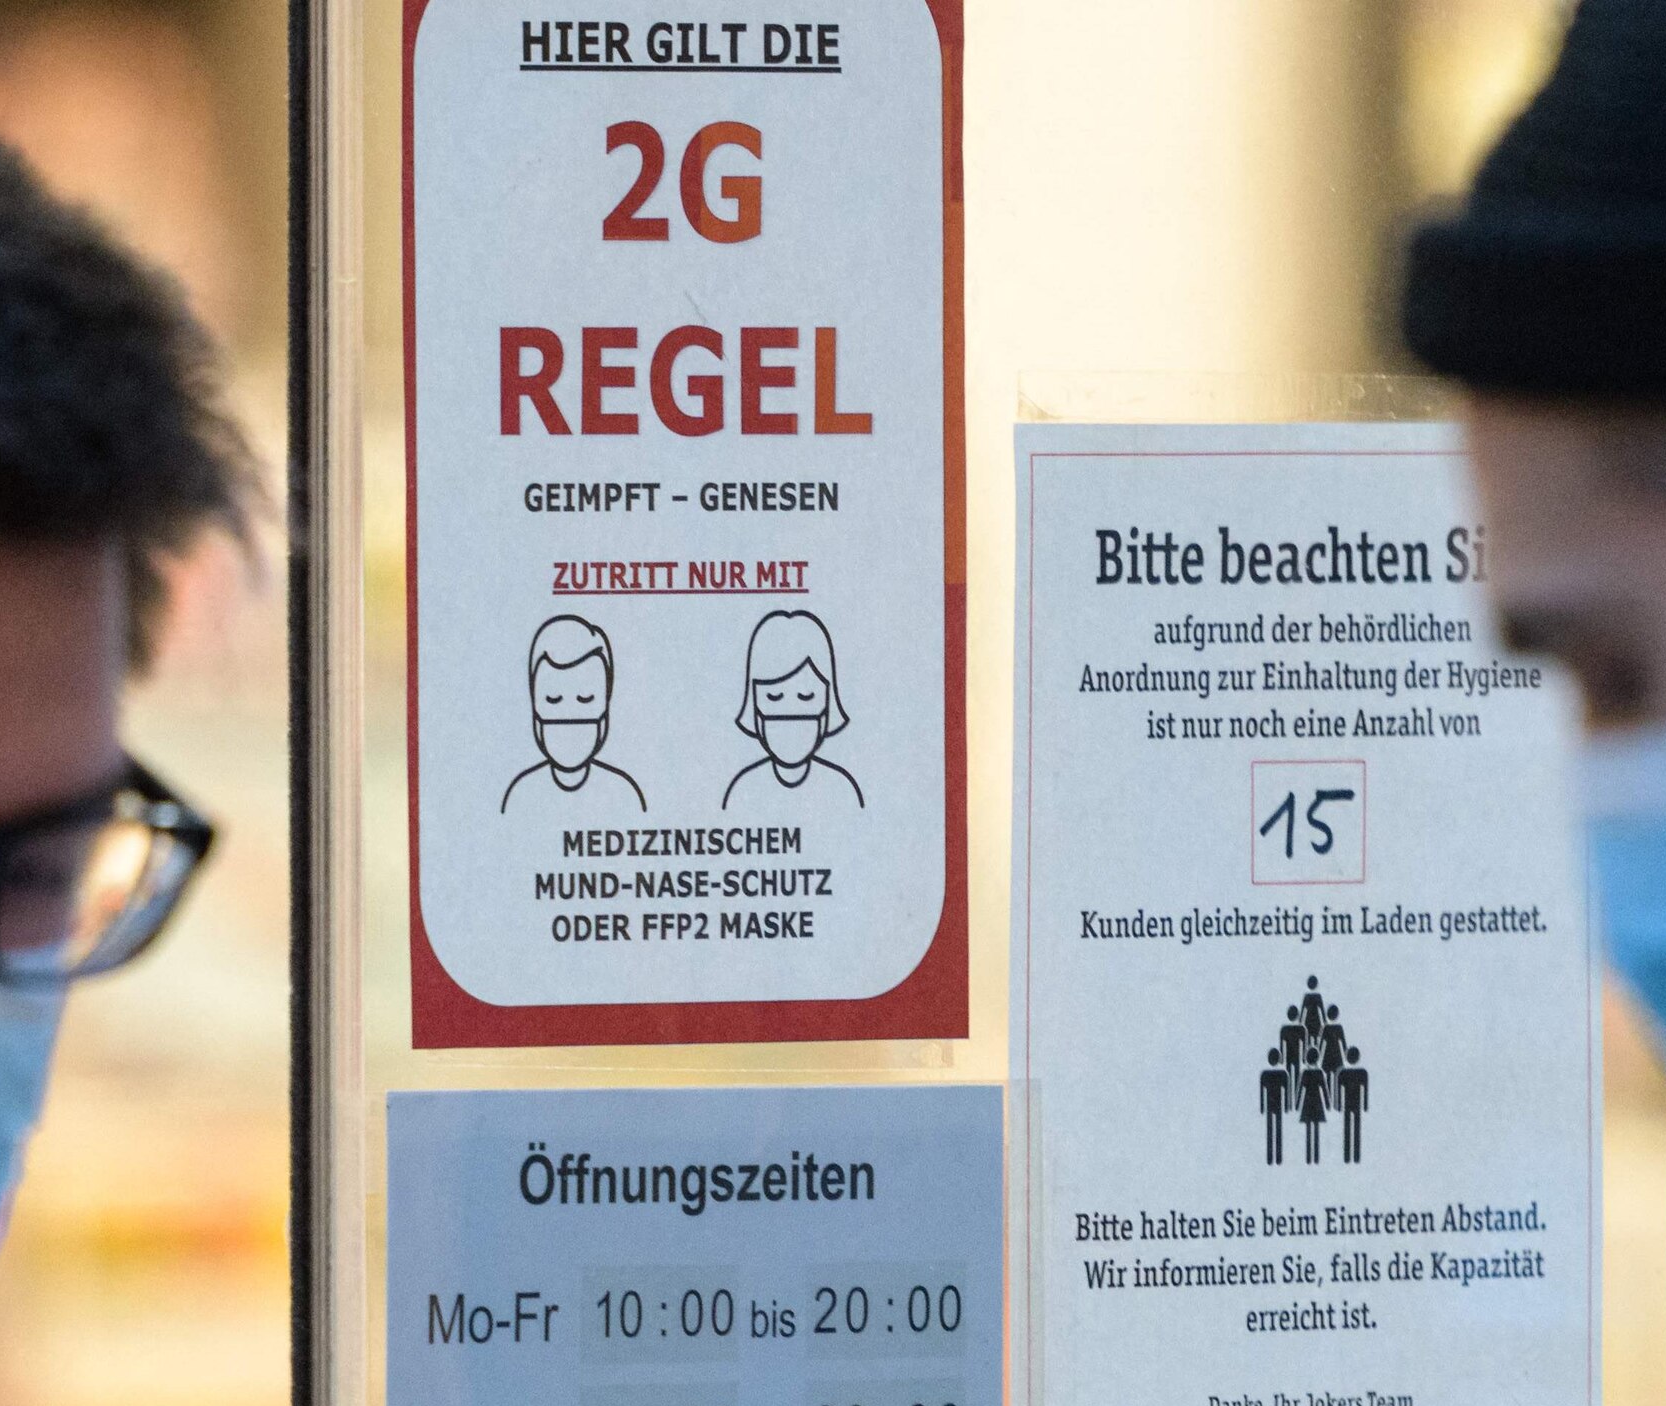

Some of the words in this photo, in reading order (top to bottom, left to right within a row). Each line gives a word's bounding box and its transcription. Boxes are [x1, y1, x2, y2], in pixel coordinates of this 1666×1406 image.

[522, 21, 633, 64] HIER
[647, 22, 747, 64] GILT
[763, 23, 840, 64] DIE
[602, 120, 761, 244] 2G
[499, 325, 873, 436] REGEL
[524, 482, 660, 512] GEIMPFT
[699, 482, 839, 512] GENESEN
[1095, 527, 1204, 585] Bitte
[1219, 526, 1432, 584] beachten
[1445, 526, 1487, 583] Si
[552, 562, 677, 588] ZUTRITT
[689, 562, 747, 589] NUR
[756, 561, 808, 588] MIT
[1153, 615, 1264, 650] aufgrund
[1271, 615, 1311, 644] der
[1319, 614, 1471, 643] behördlichen
[1079, 664, 1210, 697] Anordnung
[1217, 670, 1255, 692] zur
[1263, 662, 1397, 696] Einhaltung
[1403, 662, 1441, 689] der
[1447, 663, 1541, 696] Hygiene
[1147, 710, 1176, 740] ist
[1182, 716, 1223, 738] nur
[1229, 710, 1286, 738] noch
[1293, 710, 1346, 738] eine
[1353, 707, 1434, 737] Anzahl
[1439, 714, 1481, 736] von
[563, 828, 801, 857] MEDIZINISCHEM
[1259, 789, 1355, 858] 15
[535, 869, 832, 900] MUND-NASE-SCHUTZ
[552, 915, 631, 942] ODER
[643, 914, 709, 940] FFP2
[720, 912, 813, 939] MASKE
[1080, 909, 1174, 939] Kunden
[1181, 908, 1313, 943] gleichzeitig
[1321, 908, 1353, 935] im
[1360, 905, 1432, 934] Laden
[1439, 906, 1547, 939] gestattet.
[519, 1142, 876, 1216] Öffnungszeiten
[1075, 1212, 1133, 1241] Bitte
[1140, 1211, 1216, 1240] halten
[1223, 1210, 1255, 1238] Sie
[1262, 1208, 1317, 1237] beim
[1325, 1207, 1435, 1235] Eintreten
[1441, 1202, 1547, 1233] Abstand.
[1085, 1260, 1127, 1288] Wir
[1133, 1257, 1275, 1288] informieren
[1282, 1255, 1323, 1288] Sie,
[1331, 1254, 1381, 1283] falls
[1388, 1253, 1423, 1282] die
[1431, 1250, 1545, 1286] Kapazität
[427, 1292, 559, 1344] Mo-Fr
[751, 1300, 796, 1338] bis
[1246, 1303, 1335, 1332] erreicht
[1341, 1302, 1377, 1330] ist.
